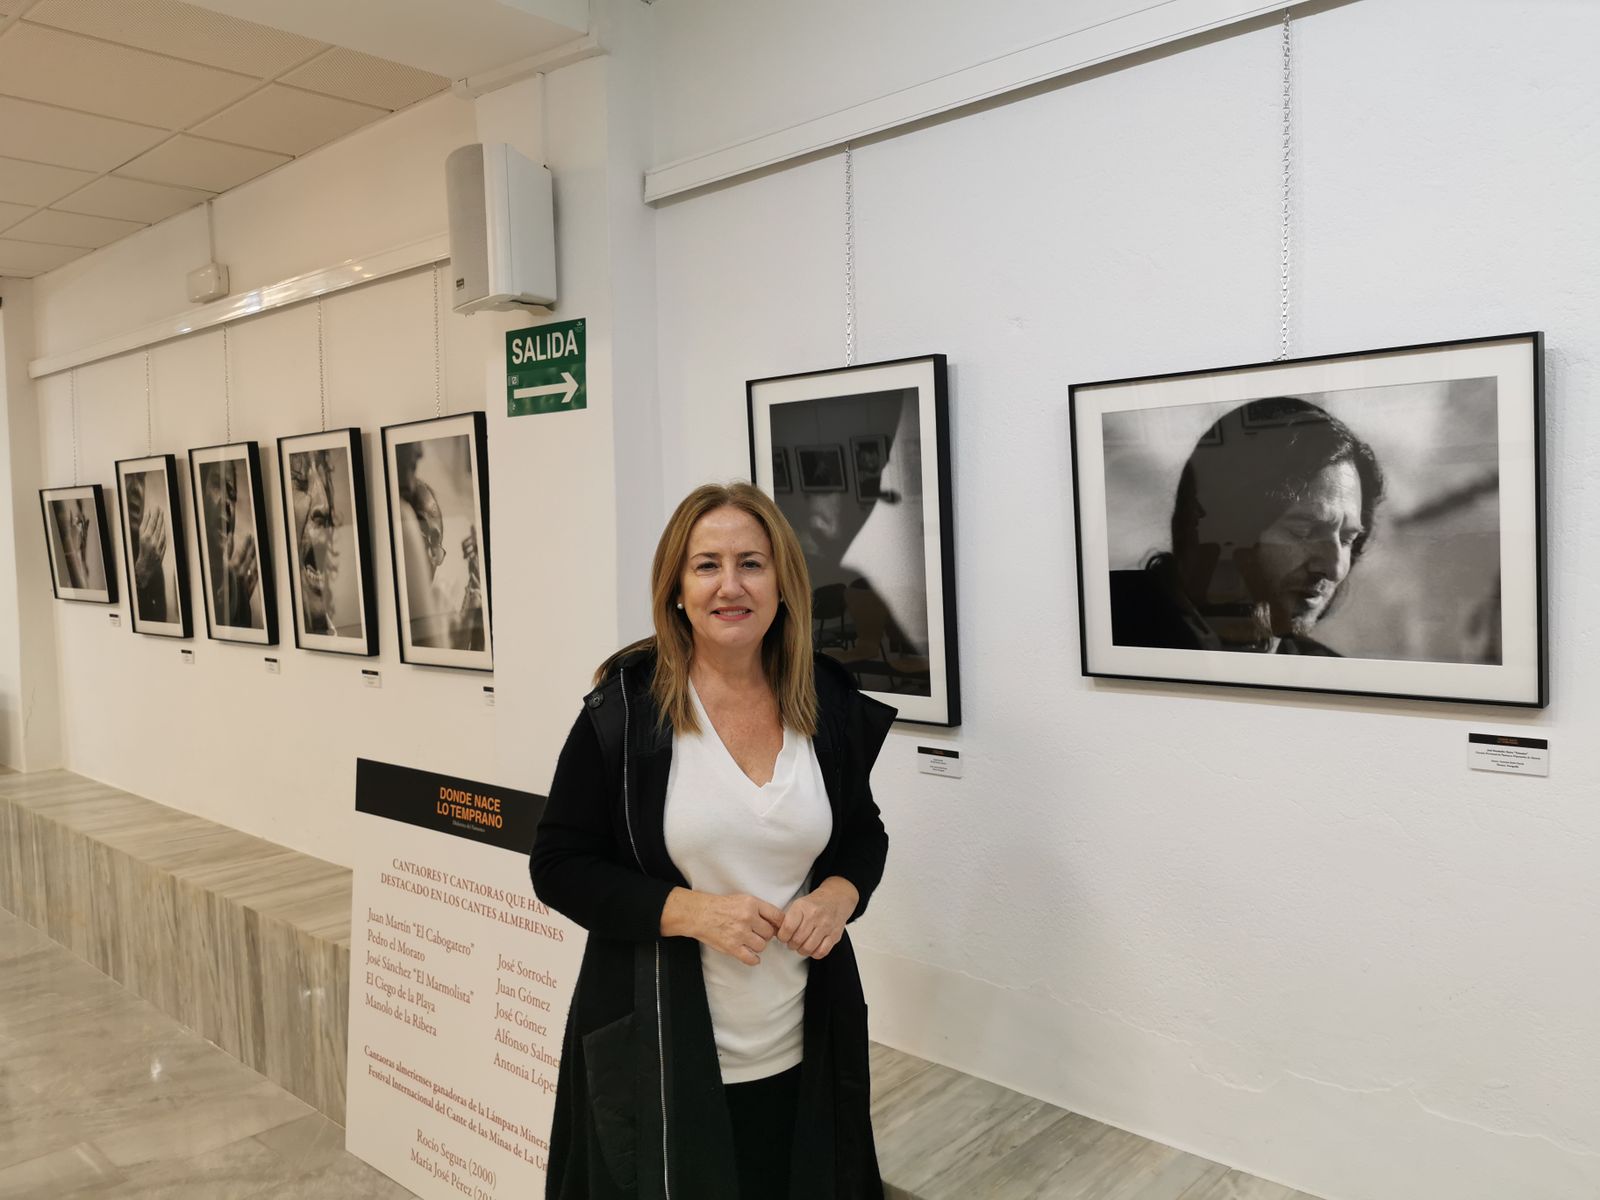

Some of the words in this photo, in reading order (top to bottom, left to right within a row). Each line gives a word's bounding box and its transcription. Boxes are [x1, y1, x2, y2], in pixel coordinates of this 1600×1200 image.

[512, 330, 578, 364] SALIDA
[437, 801, 450, 816] LO
[450, 804, 502, 828] TEMPRANO
[440, 787, 472, 806] DONDE
[474, 796, 500, 812] NACE
[392, 858, 442, 884] CANTAORES
[442, 873, 448, 884] Y
[450, 875, 504, 902] CANTAORAS
[506, 892, 526, 908] QUE
[527, 899, 550, 916] HAN
[368, 907, 384, 924] Juan
[386, 913, 411, 934] Martín
[381, 872, 429, 898] DESTACADO
[430, 888, 442, 901] EN
[443, 893, 460, 908] LOS
[461, 898, 496, 920] CANTES
[498, 910, 564, 942] ALMERIENSES
[368, 928, 388, 948] Pedro
[390, 938, 396, 951] el
[398, 940, 426, 962] Morato
[366, 950, 381, 967] José
[382, 955, 412, 979] Sánchez
[497, 954, 515, 972] José
[517, 960, 557, 989] Sorroche
[366, 972, 374, 985] El
[375, 975, 396, 997] Ciego
[397, 984, 406, 999] de
[408, 989, 414, 1002] la
[416, 994, 436, 1014] Playa
[496, 978, 516, 998] Juan
[518, 988, 551, 1012] Gómez
[366, 993, 392, 1016] Manolo
[394, 1006, 403, 1020] de
[404, 1010, 412, 1024] la
[412, 1014, 436, 1036] Ribera
[494, 1002, 513, 1020] José
[514, 1011, 547, 1037] Gómez
[494, 1028, 529, 1054] Alfonso
[493, 1052, 530, 1080] Antonia
[364, 1045, 395, 1069] Cantaoras
[396, 1060, 432, 1089] almerienses
[433, 1082, 467, 1110] ganadoras
[468, 1098, 476, 1112] de
[478, 1102, 484, 1116] la
[486, 1107, 518, 1134] Lámpara
[520, 1125, 548, 1150] Minera
[368, 1064, 391, 1085] Festival
[392, 1077, 434, 1108] Internacional
[435, 1098, 445, 1116] del
[446, 1108, 468, 1127] Cante
[468, 1118, 477, 1132] de
[478, 1122, 488, 1138] las
[489, 1130, 512, 1152] Minas
[513, 1142, 522, 1157] de
[524, 1150, 534, 1165] La
[410, 1148, 432, 1172] María
[434, 1162, 450, 1182] José
[451, 1172, 472, 1197] Pérez
[416, 1128, 439, 1151] Rocío
[441, 1142, 467, 1170] Segura
[468, 1159, 496, 1190] (2000)
